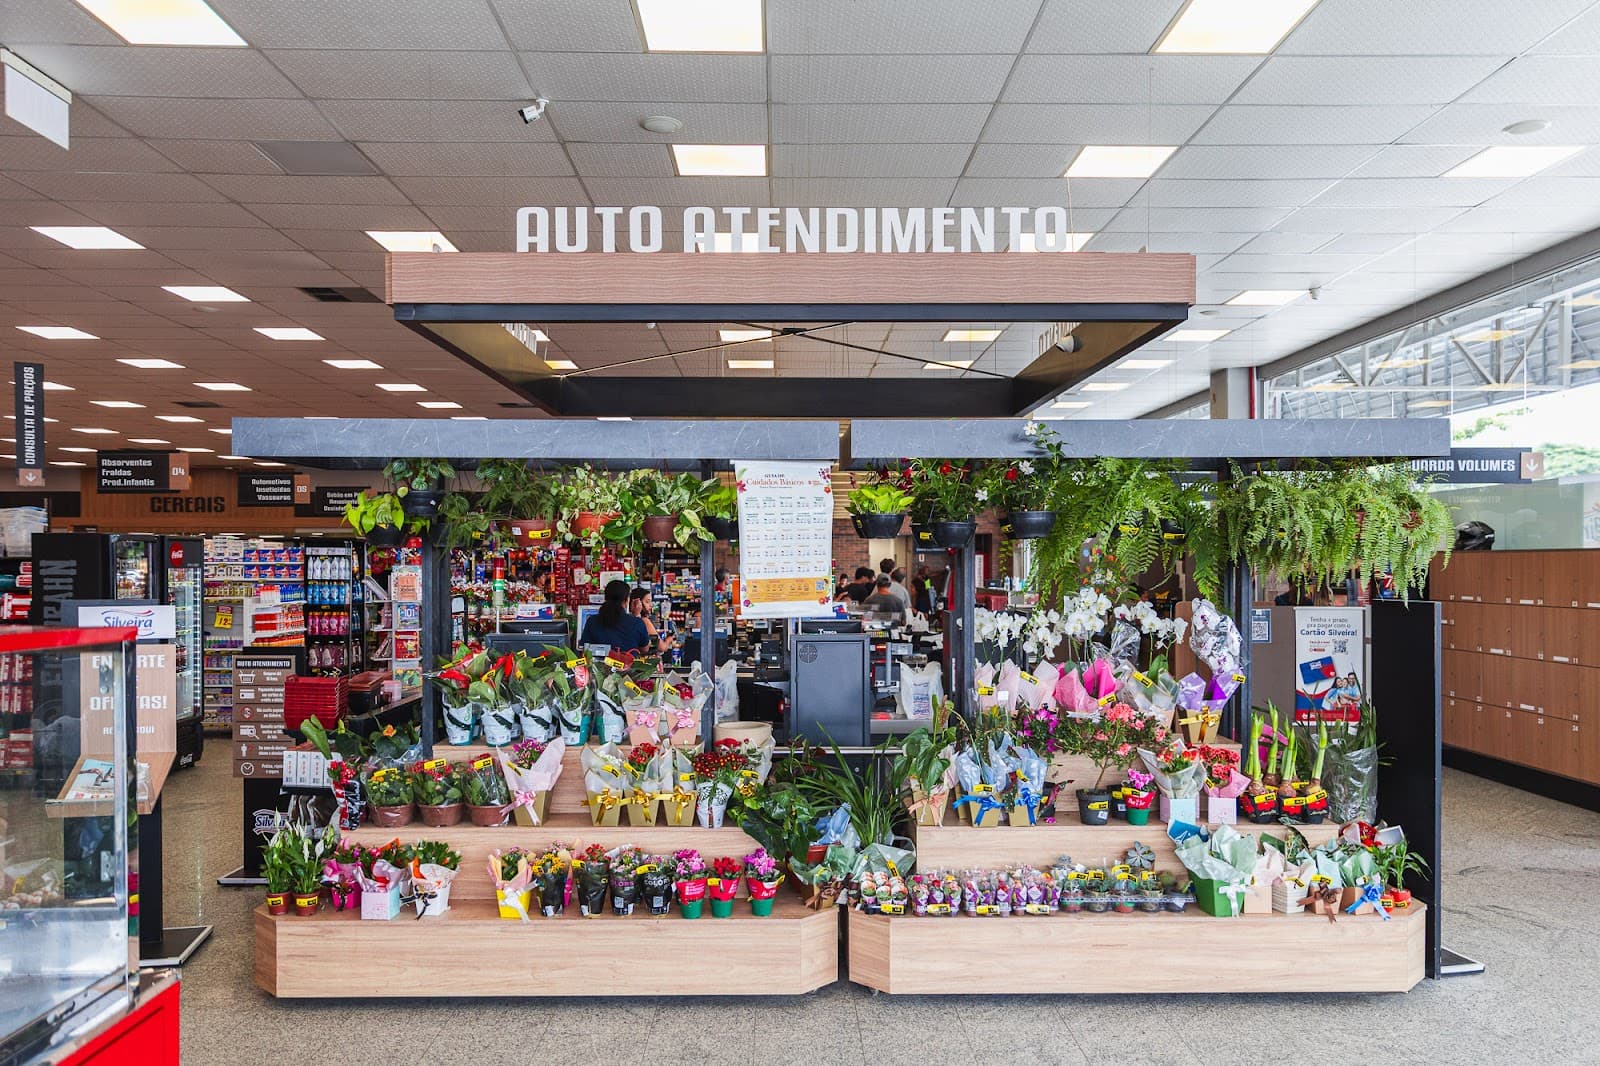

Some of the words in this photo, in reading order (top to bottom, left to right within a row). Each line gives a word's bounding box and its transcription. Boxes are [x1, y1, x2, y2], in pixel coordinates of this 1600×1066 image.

[516, 206, 662, 253] AUTO
[684, 206, 1067, 253] ATENDIMENTO
[24, 366, 36, 402] PREÇOS
[25, 403, 35, 416] DE
[25, 418, 35, 465] CONSULTA
[102, 468, 132, 476] Fraldas
[172, 467, 185, 476] 04
[1410, 459, 1454, 472] UARDA
[1458, 459, 1516, 472] VOLUMES
[151, 496, 225, 513] CEREAIS
[104, 616, 153, 628] Silveira
[1300, 628, 1326, 636] Cartão
[92, 655, 166, 669] ENRTE
[90, 695, 167, 710] OFAS!
